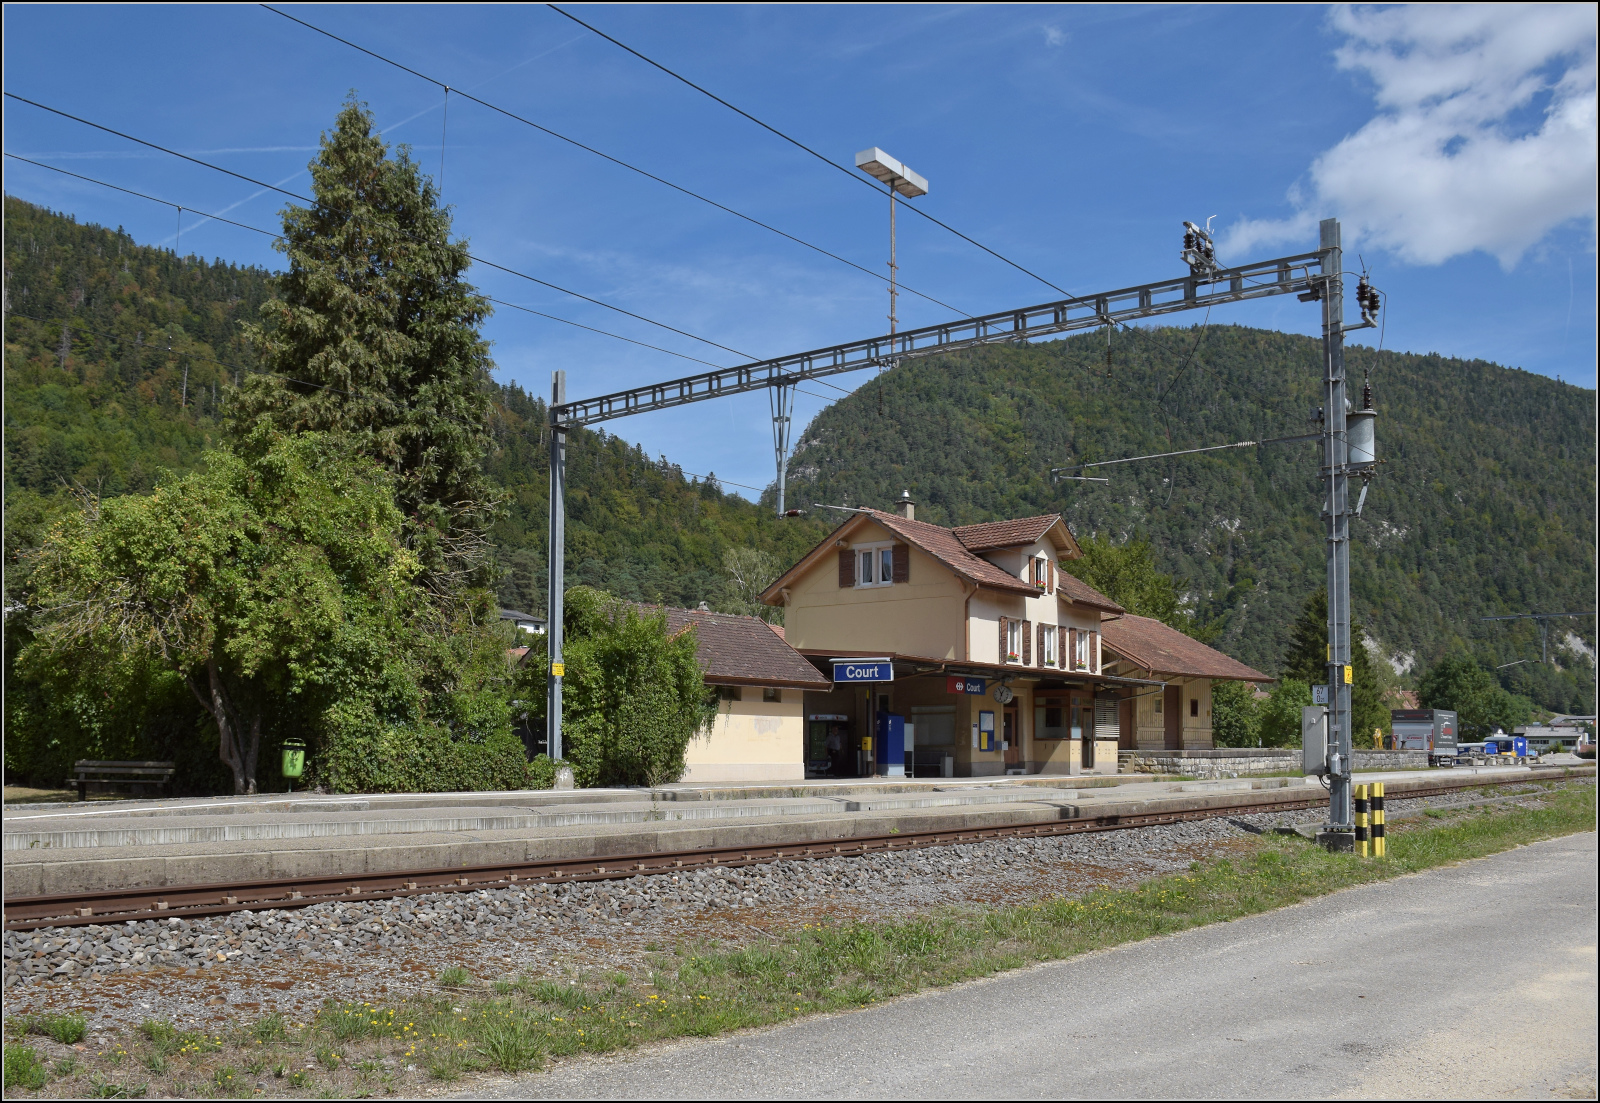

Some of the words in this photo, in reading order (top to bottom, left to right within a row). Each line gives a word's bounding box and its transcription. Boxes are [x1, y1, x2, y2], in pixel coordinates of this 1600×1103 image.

[846, 665, 879, 679] Court
[966, 683, 981, 693] Court
[1316, 686, 1324, 695] 67
